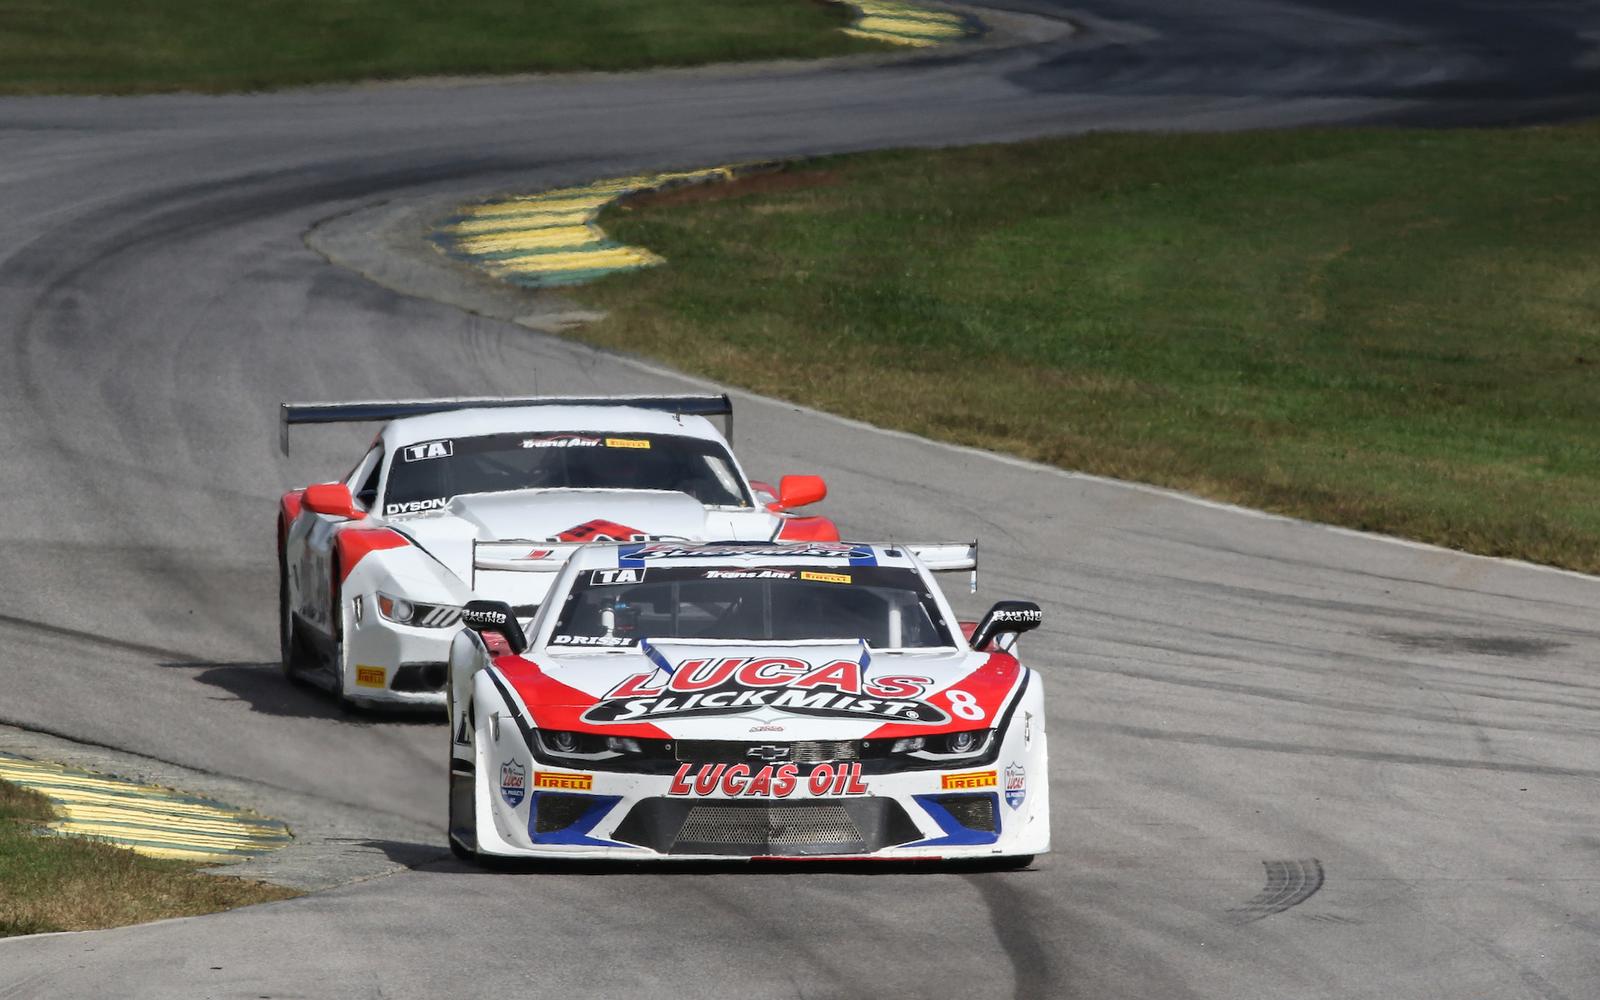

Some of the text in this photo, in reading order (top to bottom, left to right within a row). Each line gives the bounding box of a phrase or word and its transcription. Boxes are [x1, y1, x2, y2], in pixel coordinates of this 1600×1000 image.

[410, 442, 447, 459] TA
[386, 497, 446, 515] DYSON
[600, 569, 637, 583] TA
[705, 570, 791, 579] Trans Am
[804, 573, 848, 582] PIRELLI
[553, 635, 632, 647] DRISSI
[602, 657, 935, 700] LUCAS
[946, 689, 986, 721] 8
[534, 771, 593, 790] PIRELLI
[667, 762, 870, 798] LUCAS OIL
[941, 770, 998, 790] PIRELLI
